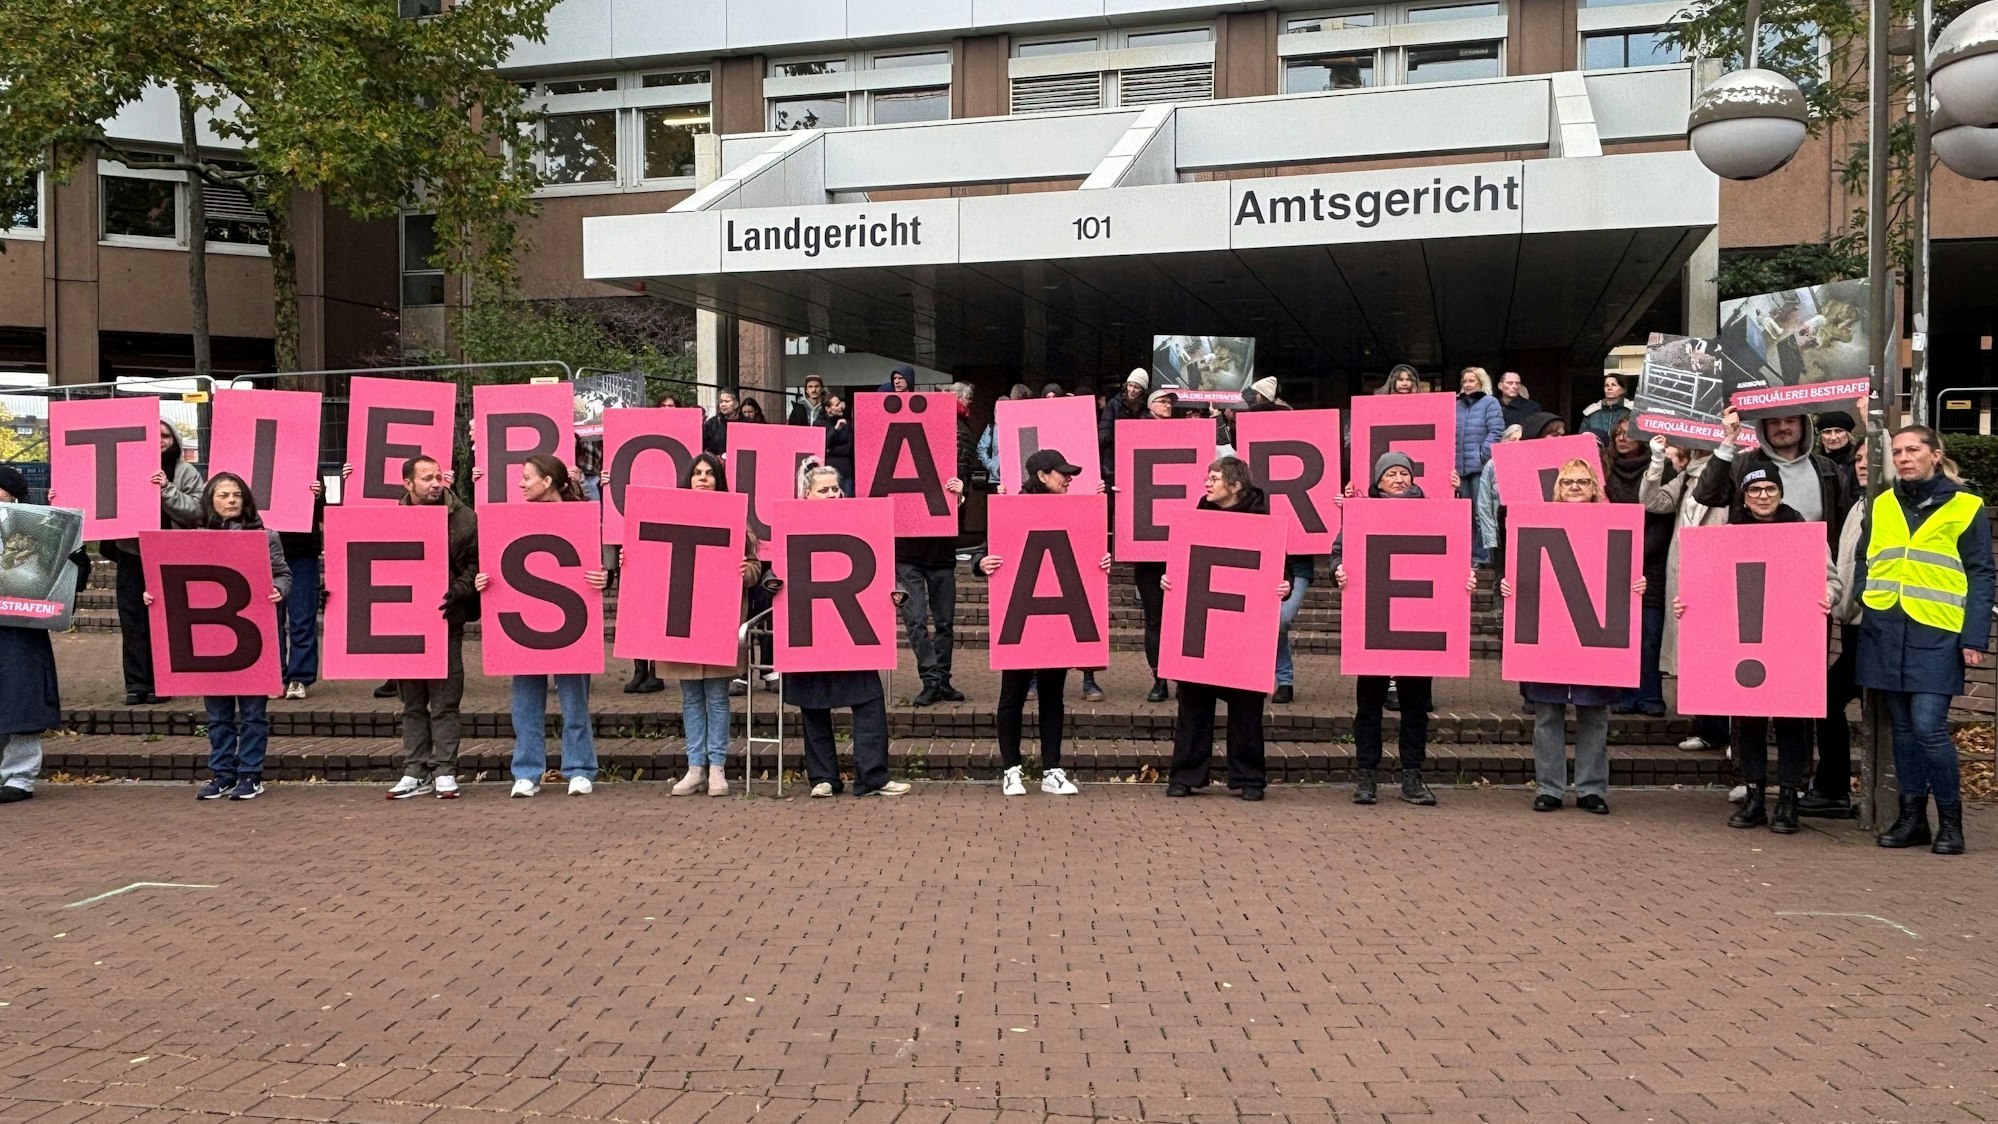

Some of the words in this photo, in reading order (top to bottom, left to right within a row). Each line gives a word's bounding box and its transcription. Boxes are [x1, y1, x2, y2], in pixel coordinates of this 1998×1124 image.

[1234, 175, 1519, 228] Amtsgericht
[727, 213, 921, 257] Landgericht
[1072, 215, 1111, 240] 101
[1736, 390, 1808, 406] TIERQUÄLEREI
[1644, 418, 1711, 437] TIERQUÄLEREI
[0, 600, 55, 614] STRAFEN!
